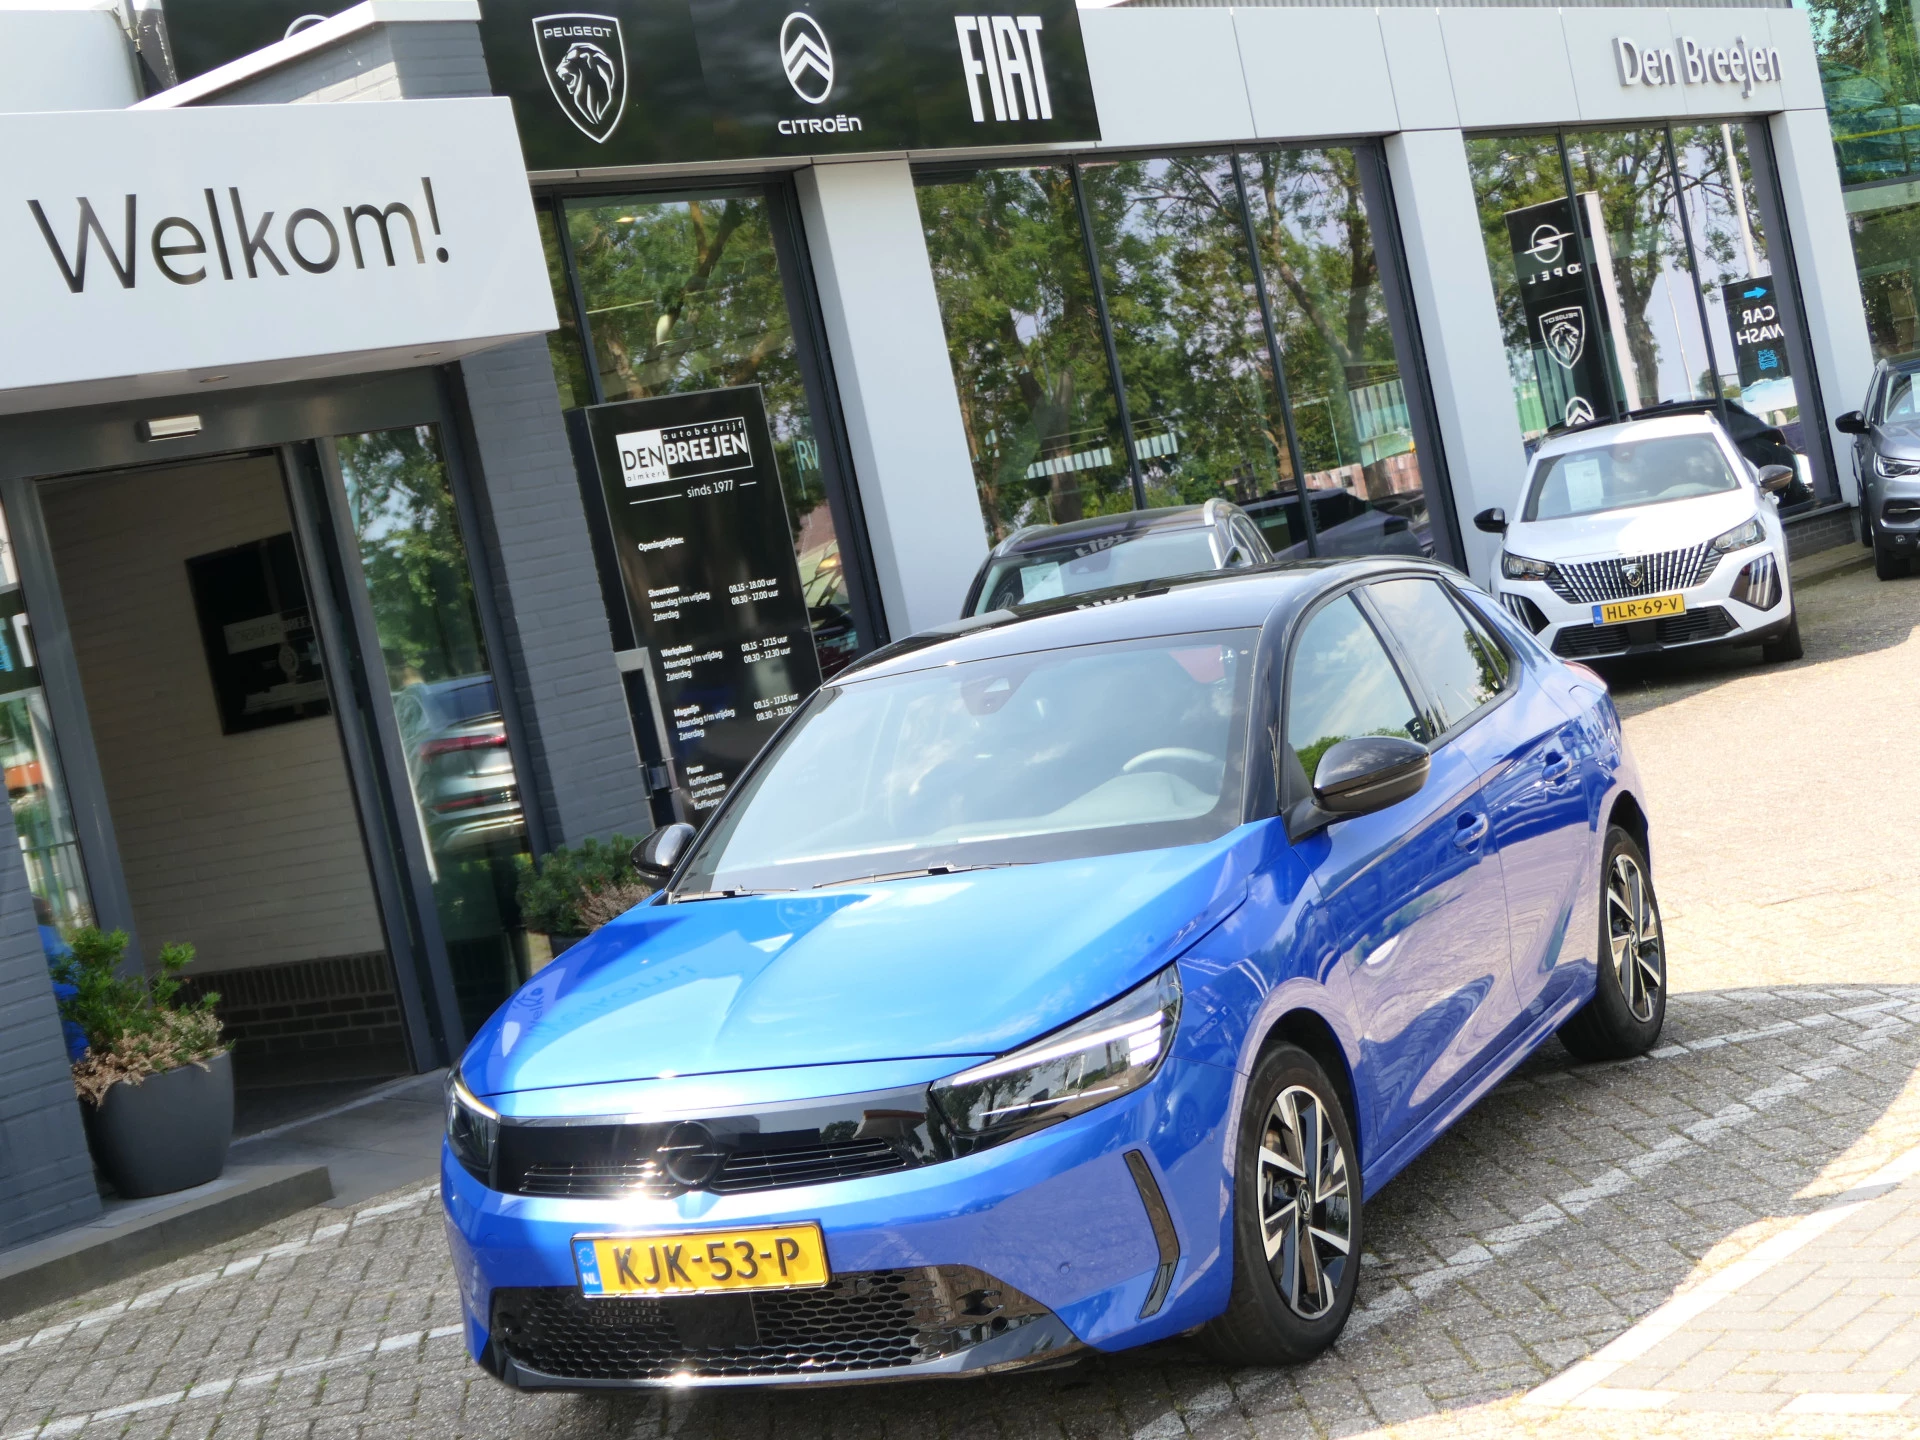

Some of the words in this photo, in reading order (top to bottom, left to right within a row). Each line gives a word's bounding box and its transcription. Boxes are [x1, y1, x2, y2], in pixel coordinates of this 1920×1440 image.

[543, 26, 612, 39] PEUGEOT
[954, 15, 1053, 122] FIAT
[1612, 36, 1678, 87] Den
[1676, 34, 1783, 99] Breejen
[26, 176, 449, 293] Welkom!
[662, 421, 743, 440] autobedrijf
[621, 445, 665, 471] DEN
[664, 433, 747, 465] BREEJEN
[627, 470, 667, 482] almkerk
[686, 485, 712, 498] sinds
[713, 480, 734, 494] 1977
[648, 586, 679, 598] Showroom
[650, 597, 679, 609] Maandag
[766, 578, 777, 586] uur
[653, 610, 680, 621] Zaterdag
[768, 590, 779, 598] uur
[1606, 597, 1677, 620] HLR-69-V
[663, 658, 691, 670] Maandag
[665, 670, 692, 682] Zaterdag
[780, 647, 791, 655] uur
[676, 717, 704, 729] Maandag
[714, 708, 736, 719] vrijdag
[788, 693, 799, 701] uur
[678, 728, 705, 741] Zaterdag
[755, 710, 772, 722] 08.30
[691, 784, 726, 798] Lunchpauze
[693, 798, 722, 810] Koffiepa
[613, 1237, 800, 1285] KJK-53-P
[583, 1273, 598, 1284] NL
